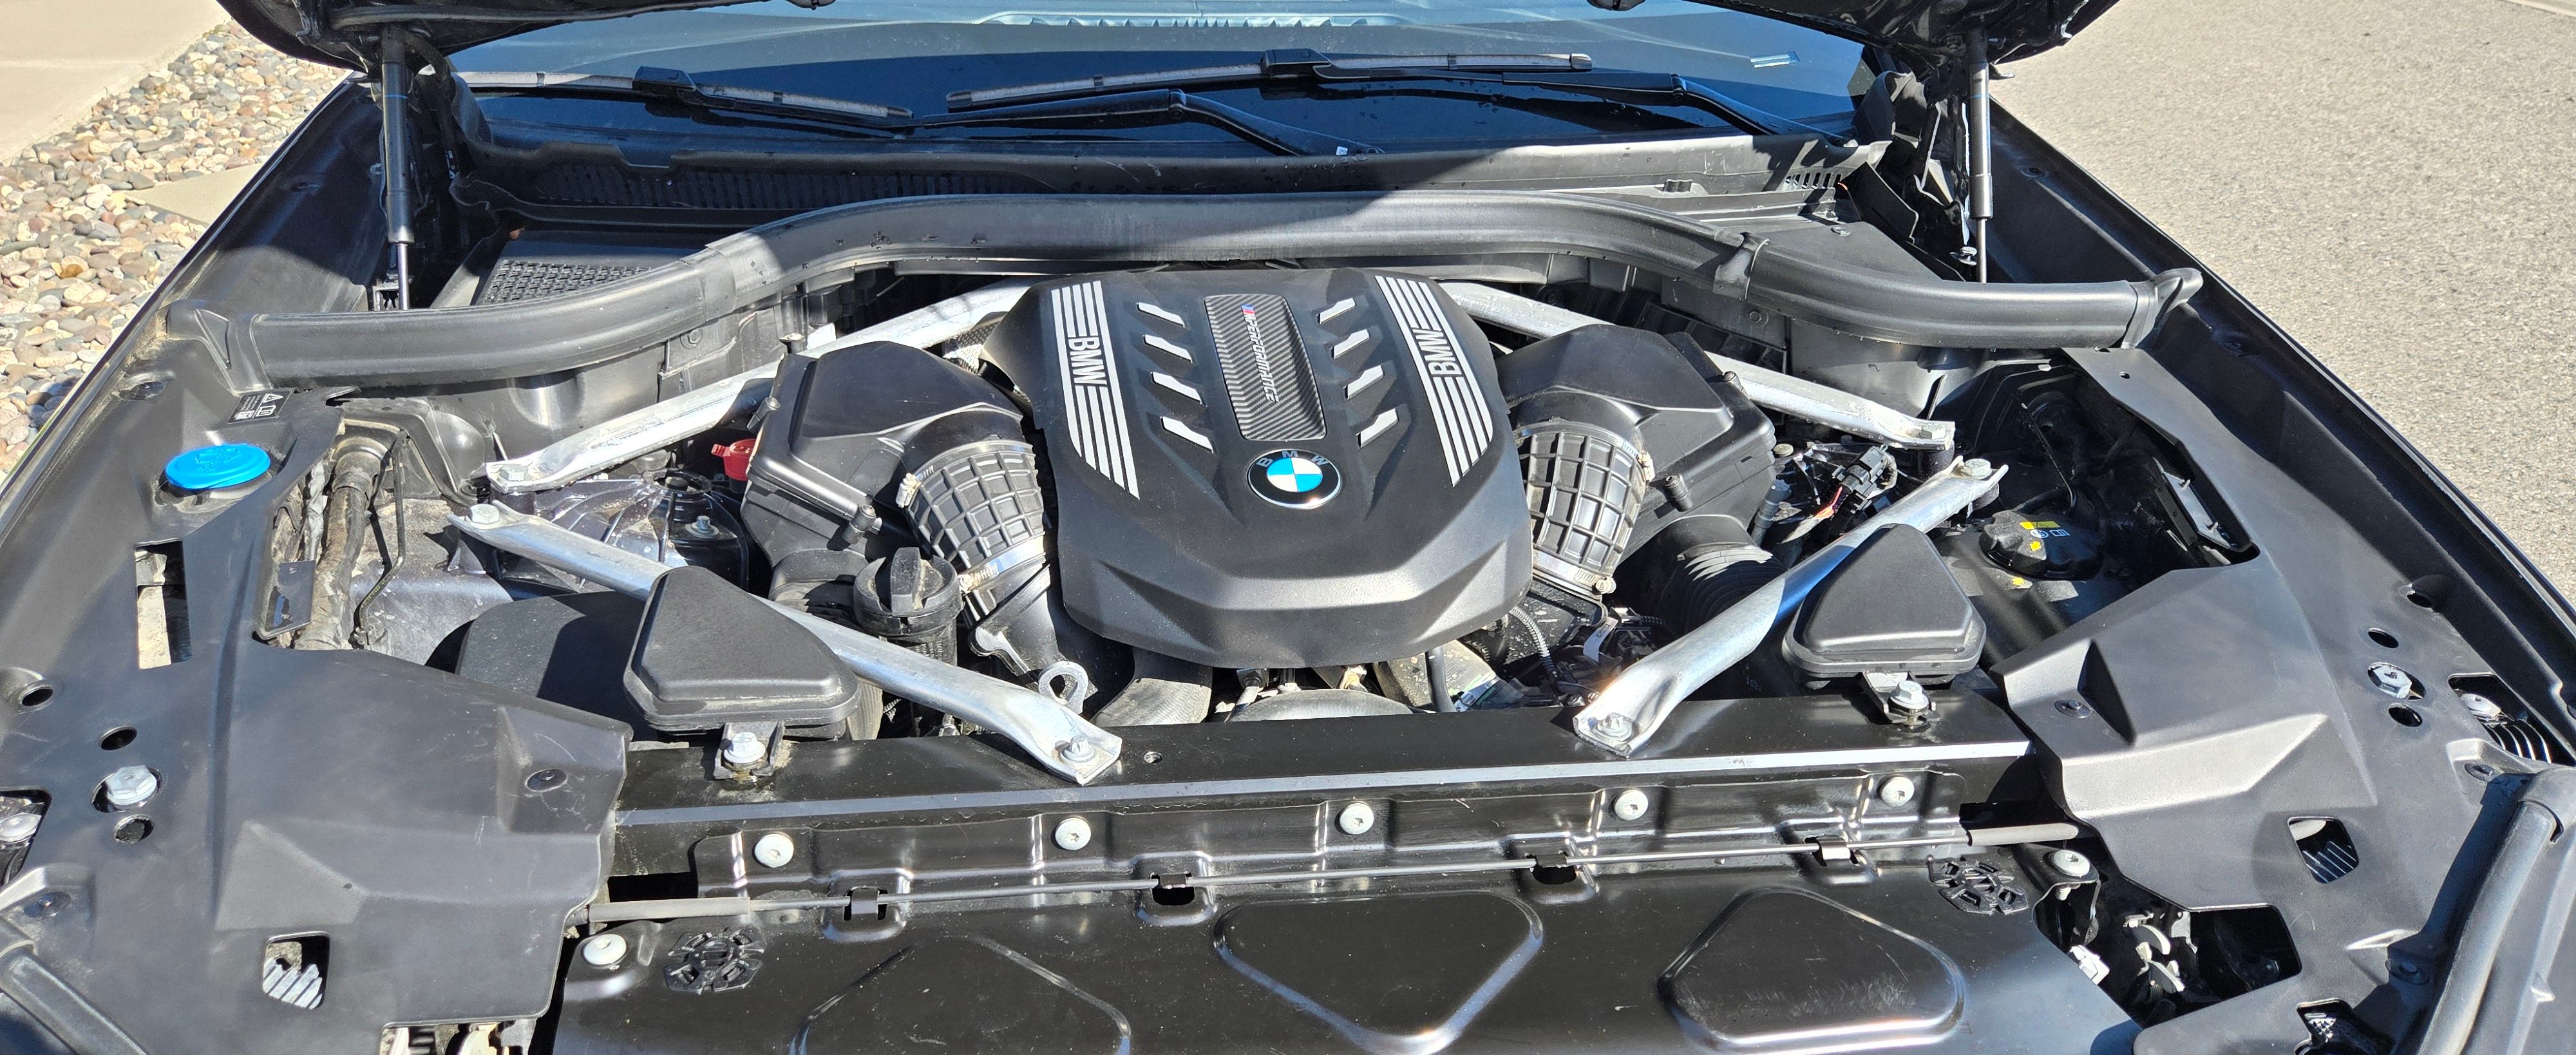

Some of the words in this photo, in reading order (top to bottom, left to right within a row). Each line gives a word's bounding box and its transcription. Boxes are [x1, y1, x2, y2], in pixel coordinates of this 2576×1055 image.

[1068, 337, 1107, 385] BMW
[1245, 320, 1279, 403] PERFORMANCE
[1412, 328, 1462, 375] BMW
[1256, 450, 1329, 468] BMW
